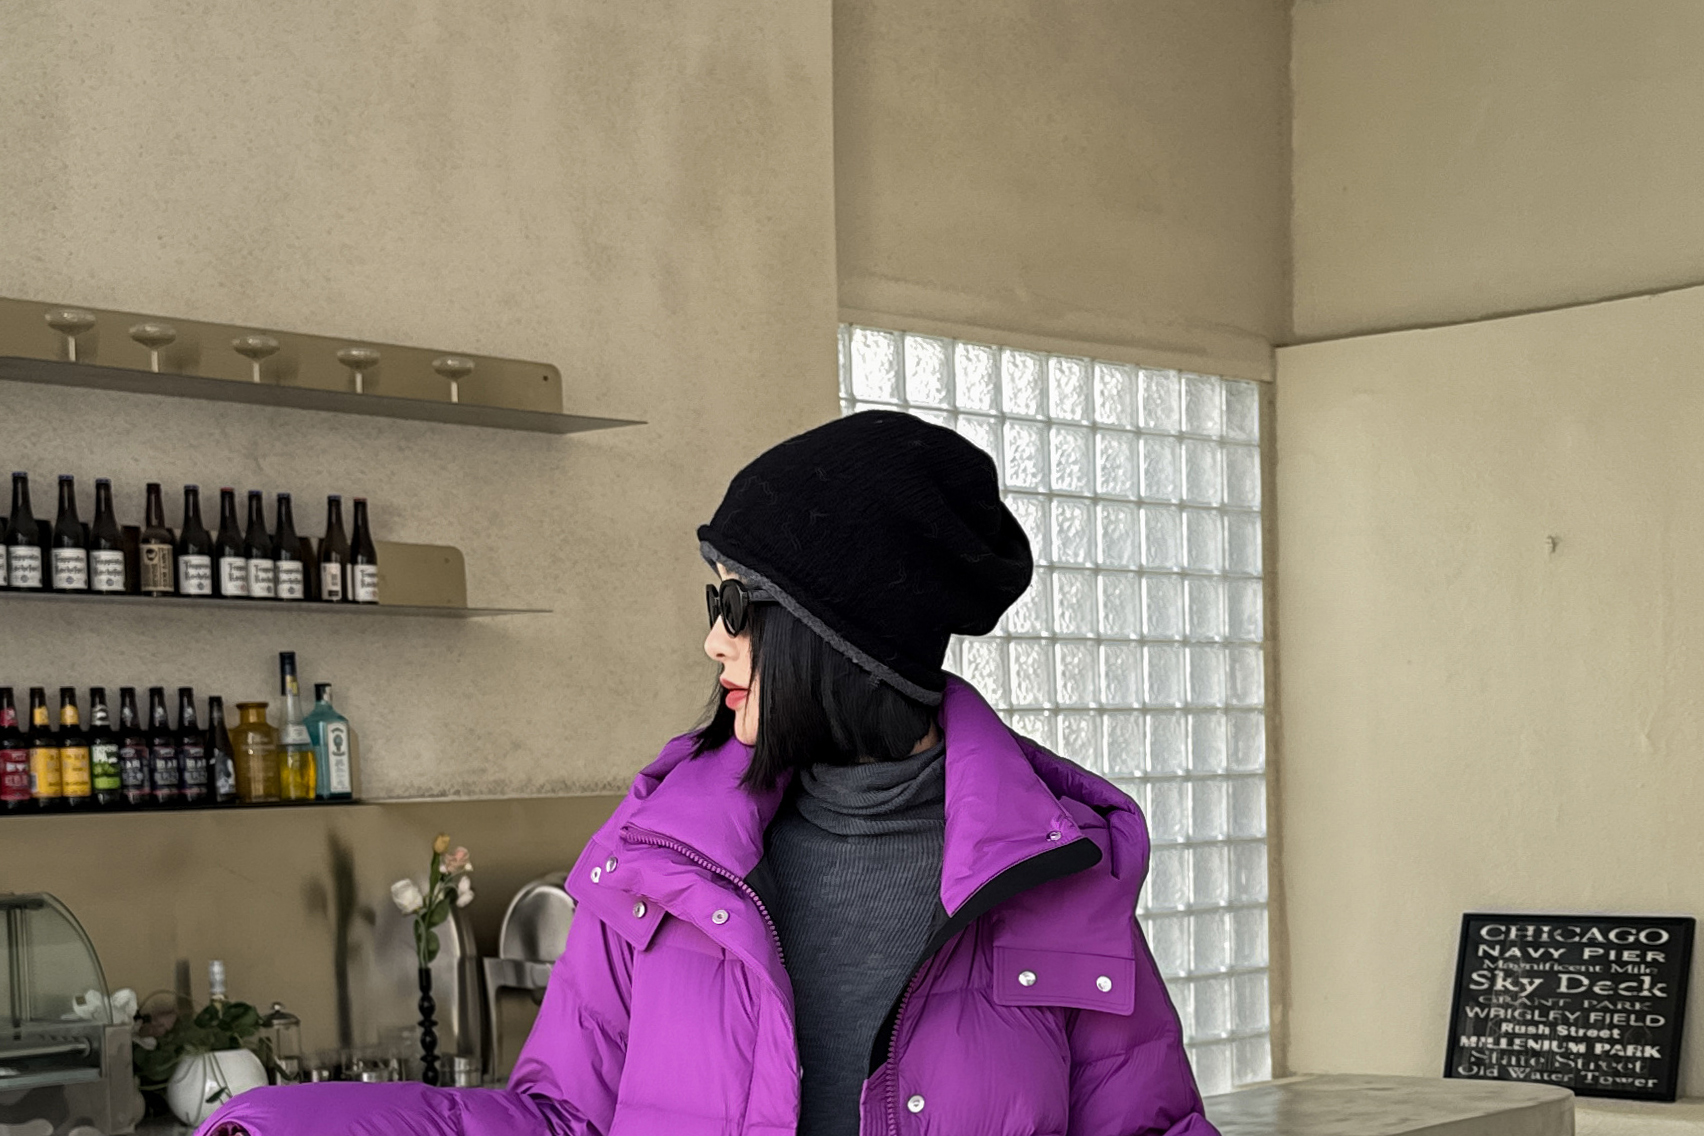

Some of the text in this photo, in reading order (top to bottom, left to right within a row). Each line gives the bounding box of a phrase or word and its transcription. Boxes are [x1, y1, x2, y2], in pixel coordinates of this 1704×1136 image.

[1480, 924, 1670, 945] CHICAGO
[1477, 944, 1666, 962] NAVY PIER
[1483, 959, 1659, 975] Magnificent Mile
[1469, 970, 1668, 998] Sky Deck
[1478, 995, 1653, 1011] GRANT PARK
[1465, 1005, 1666, 1027] WRIGLEY FIELD
[1500, 1021, 1621, 1039] Rush Street
[1460, 1035, 1662, 1059] MILLENIUM PARK
[1457, 1064, 1659, 1088] Old Water Tower
